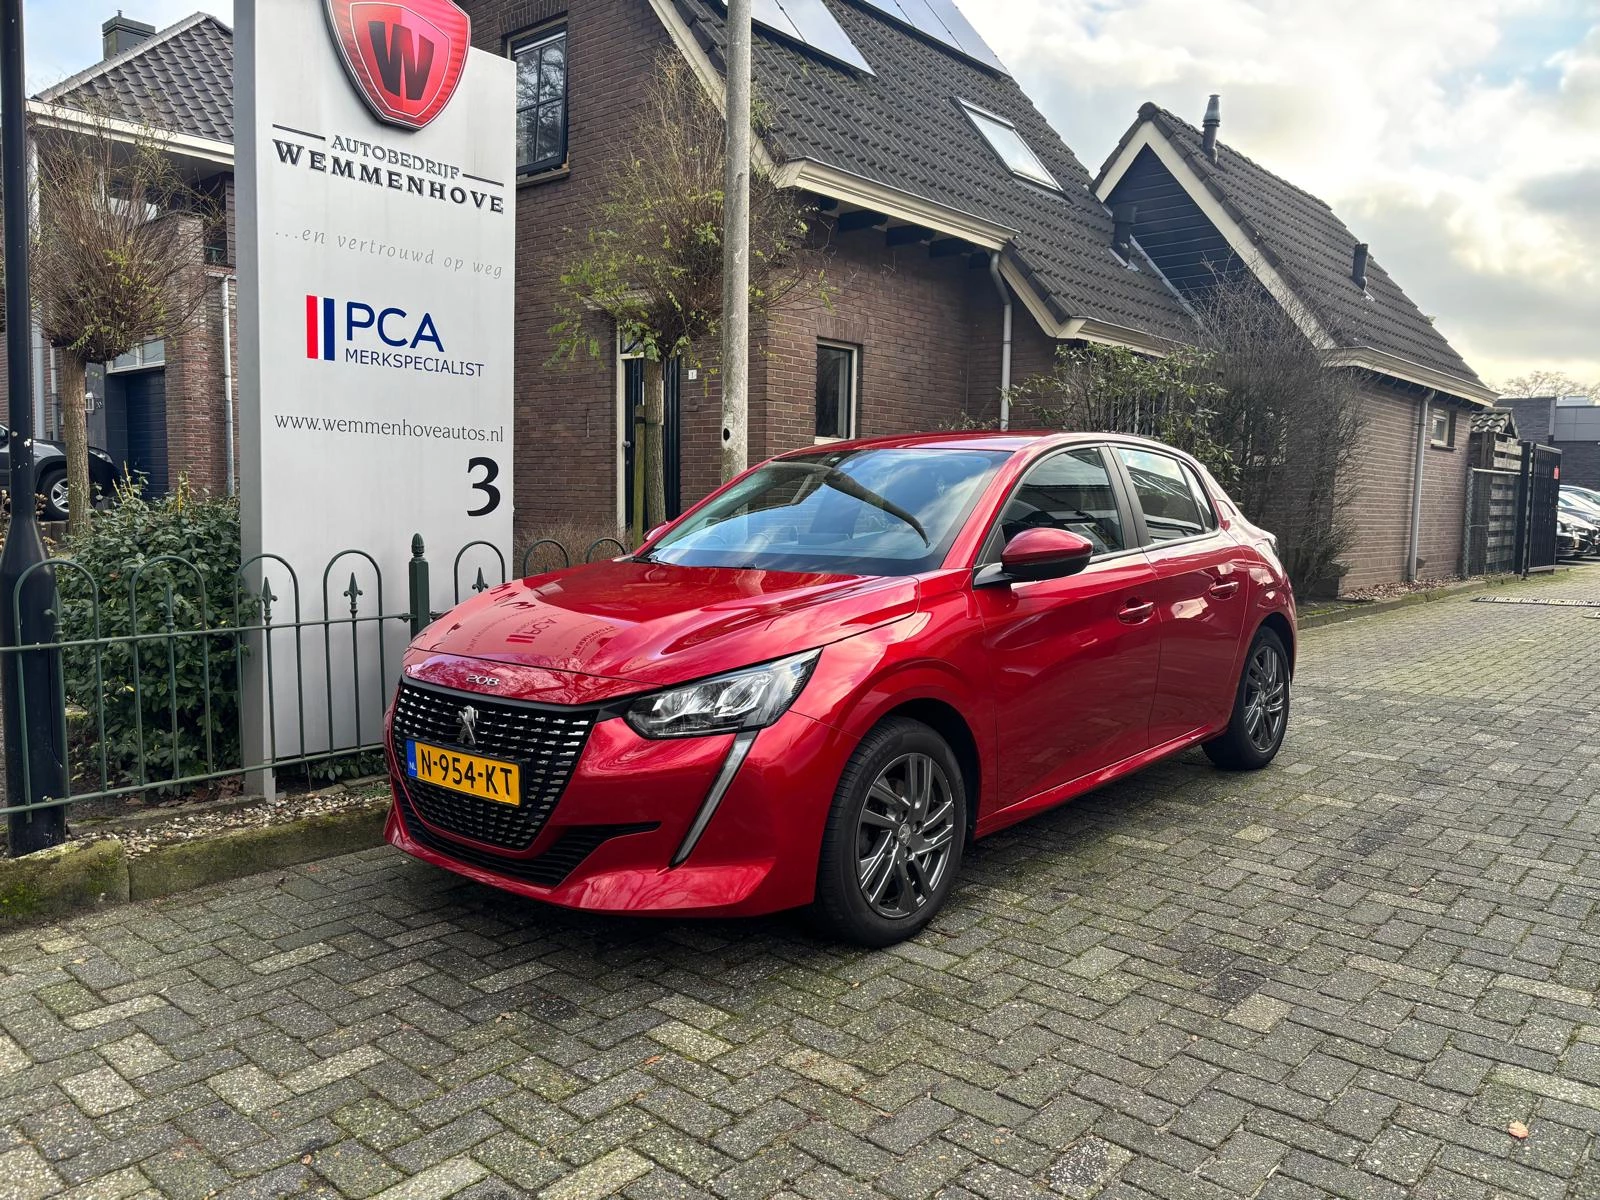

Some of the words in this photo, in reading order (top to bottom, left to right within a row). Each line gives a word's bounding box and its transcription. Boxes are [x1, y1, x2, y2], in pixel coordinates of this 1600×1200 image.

[368, 21, 434, 101] W
[272, 138, 504, 215] WEMMENHOVE
[331, 135, 460, 180] AUTOBEDRIJF
[275, 227, 326, 246] ...en
[337, 235, 435, 265] vertrouwd
[443, 256, 464, 272] op
[472, 259, 503, 280] weg
[346, 301, 445, 353] PCA
[345, 348, 484, 377] MERKSPECIALIST
[274, 414, 504, 443] www.wemmenhoveautos.nl
[466, 456, 501, 517] 3
[466, 674, 500, 686] 208
[409, 761, 416, 771] NL
[420, 748, 512, 796] N-954-KT
